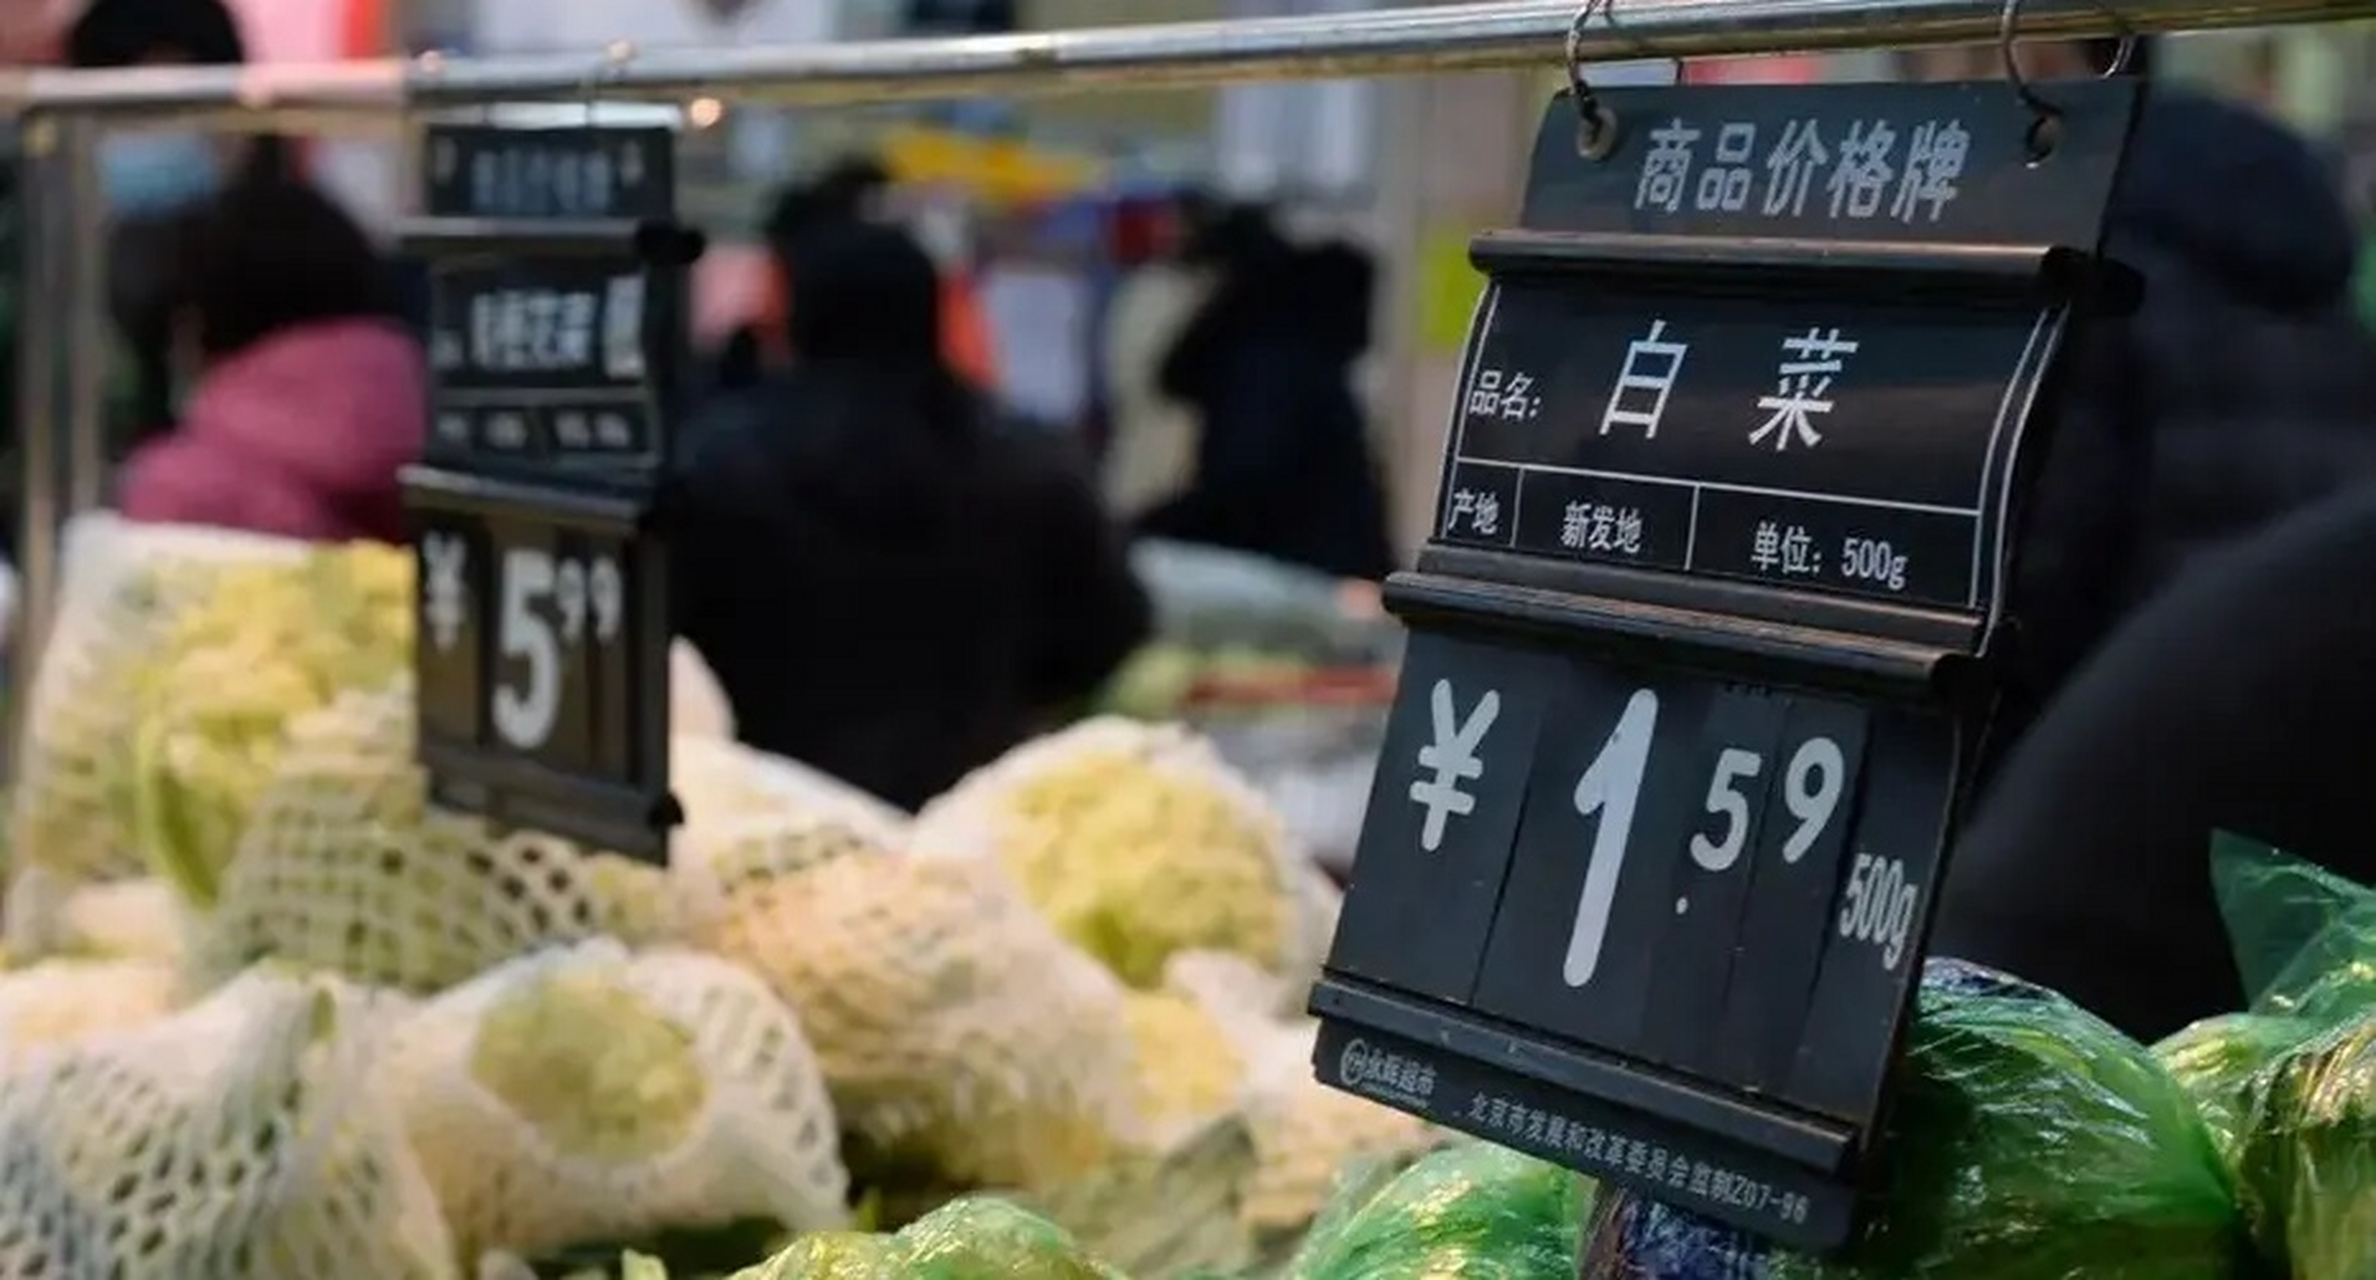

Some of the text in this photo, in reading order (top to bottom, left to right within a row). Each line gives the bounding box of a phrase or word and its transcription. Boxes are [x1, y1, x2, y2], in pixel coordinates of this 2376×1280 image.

[1634, 118, 1970, 223] 商品价格牌
[1449, 490, 1499, 535] 产地
[1561, 501, 1642, 554] 新发地
[1839, 852, 1919, 971] 500g
